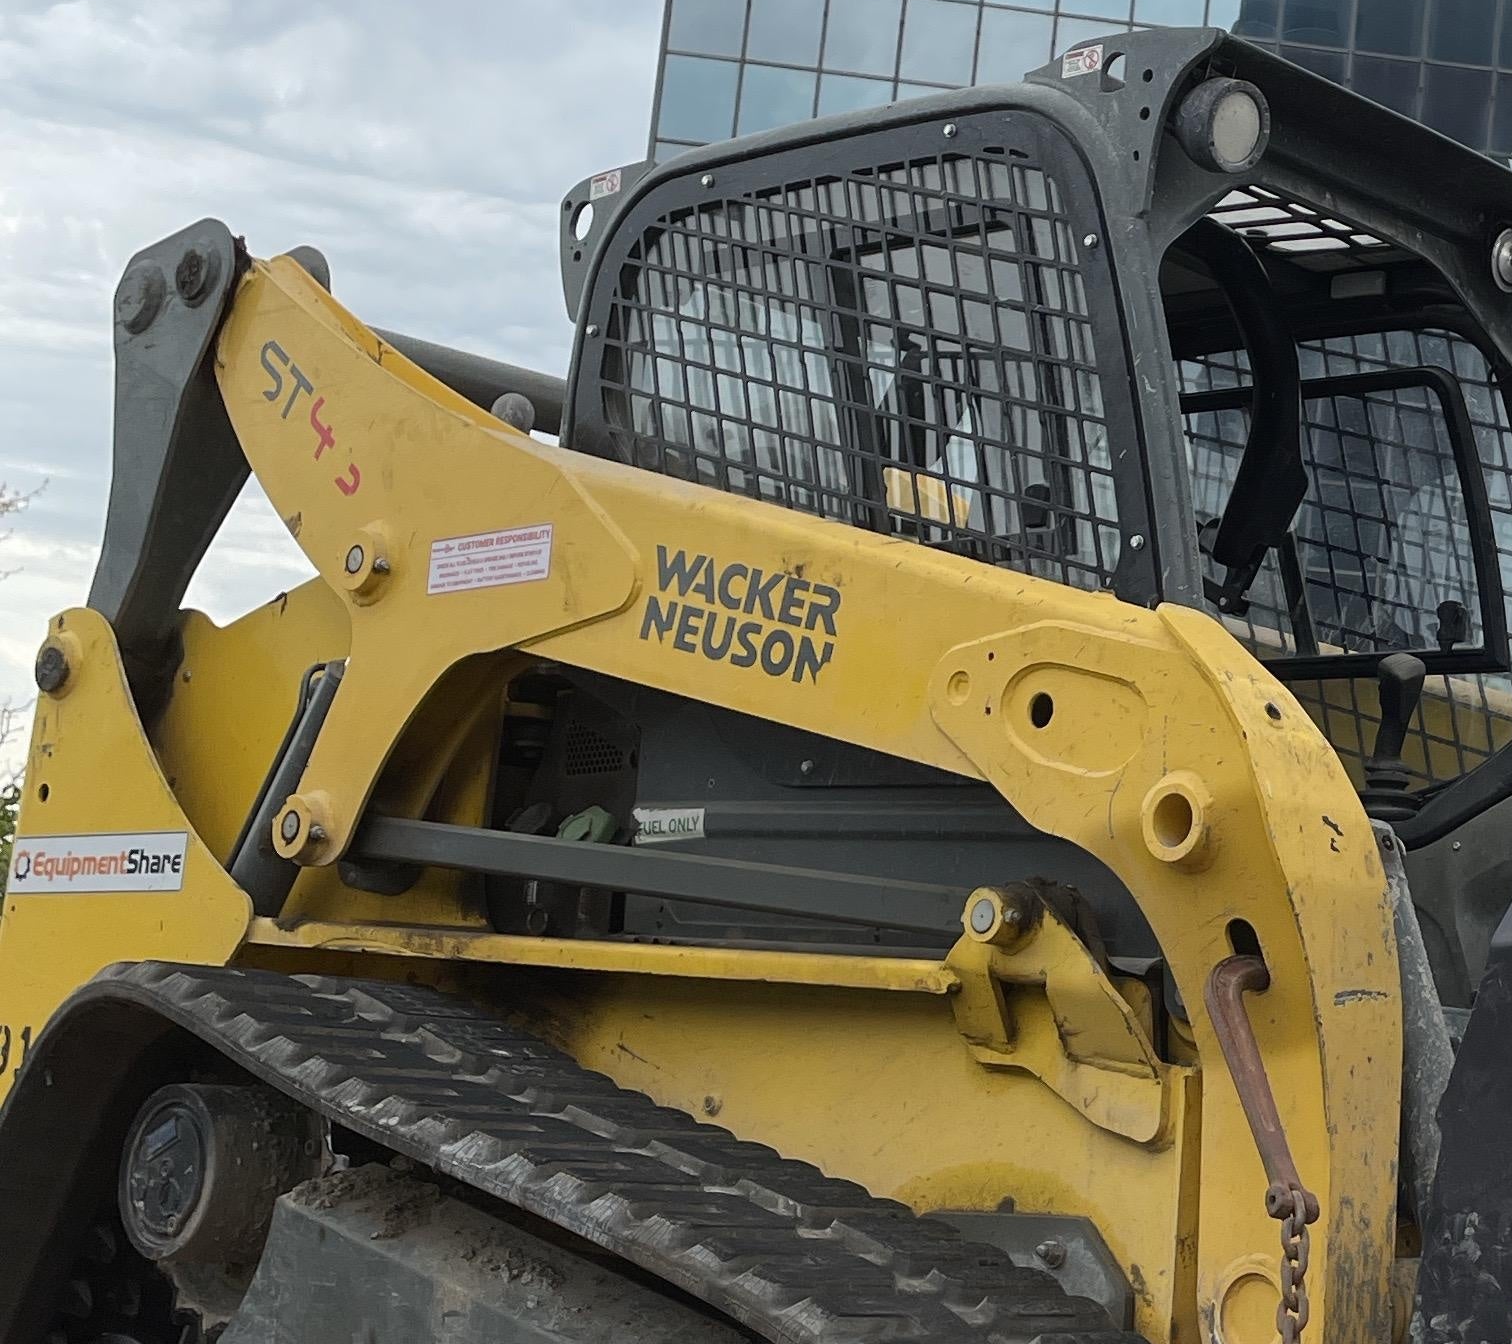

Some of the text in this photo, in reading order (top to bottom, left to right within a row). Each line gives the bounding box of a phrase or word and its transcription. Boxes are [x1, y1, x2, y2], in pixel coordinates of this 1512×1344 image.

[656, 543, 842, 638] WACKER
[639, 594, 835, 686] NEUSON
[668, 815, 700, 833] ONLY
[33, 849, 182, 882] EquipmentShare
